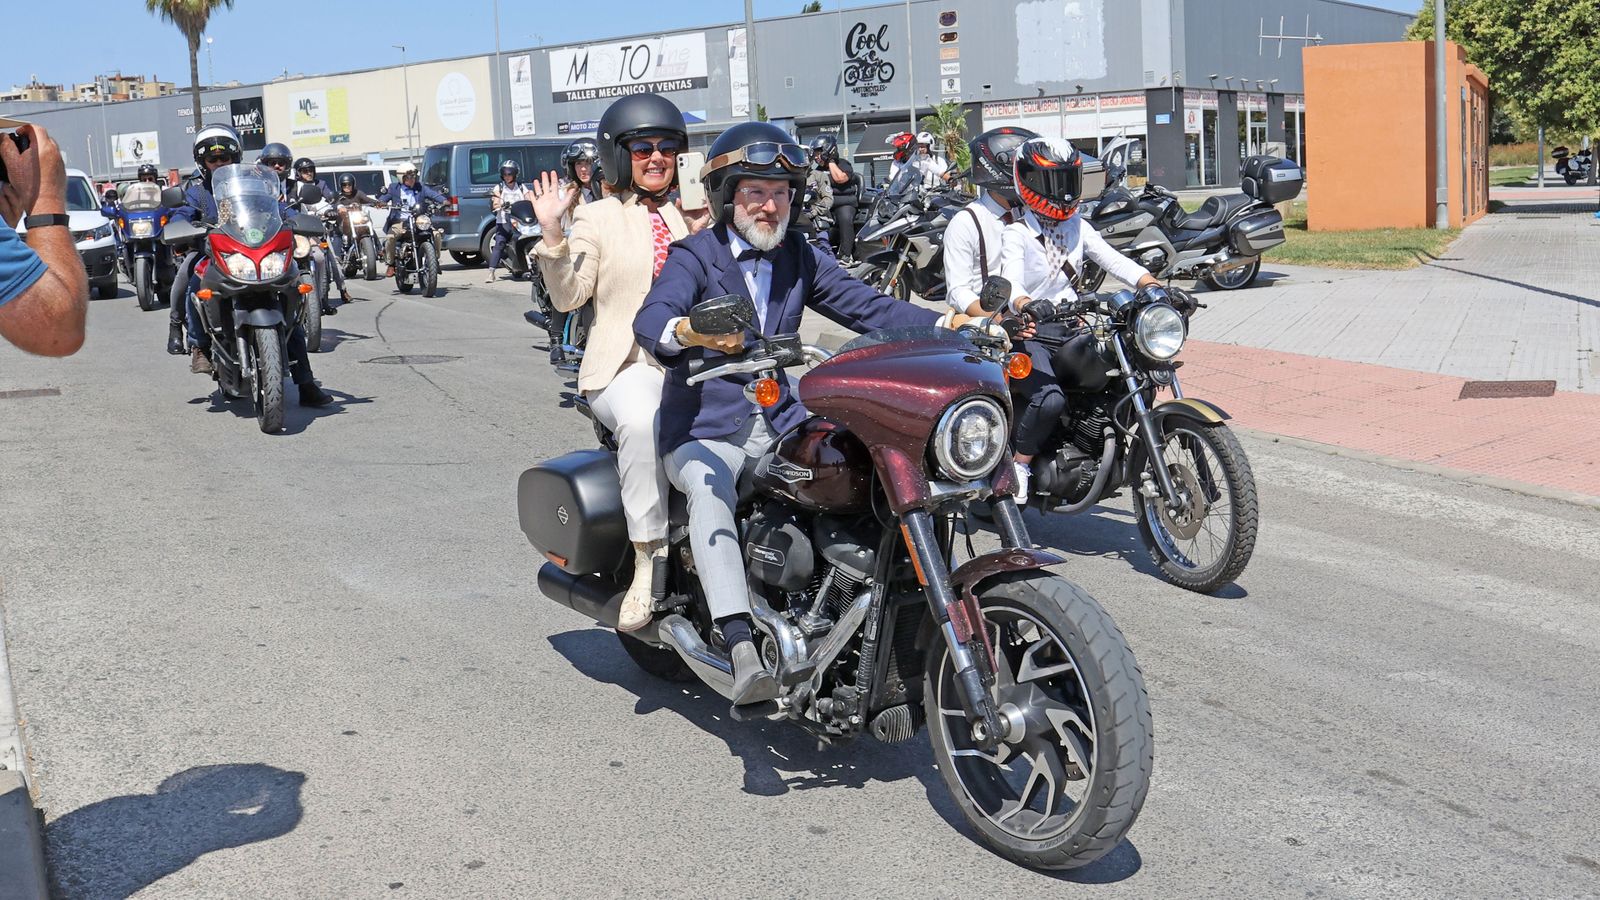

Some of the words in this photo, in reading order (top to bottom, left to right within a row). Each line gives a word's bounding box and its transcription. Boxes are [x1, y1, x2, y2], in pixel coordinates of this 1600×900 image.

[845, 22, 889, 58] Cool
[566, 89, 597, 101] TALLER
[599, 84, 645, 98] MECANICO
[648, 83, 654, 92] Y
[656, 80, 692, 91] VENTAS
[984, 101, 1019, 115] POTENCIA
[1023, 99, 1059, 113] EQUILIBRIO
[233, 113, 252, 127] YAK
[978, 156, 1002, 180] SHARK
